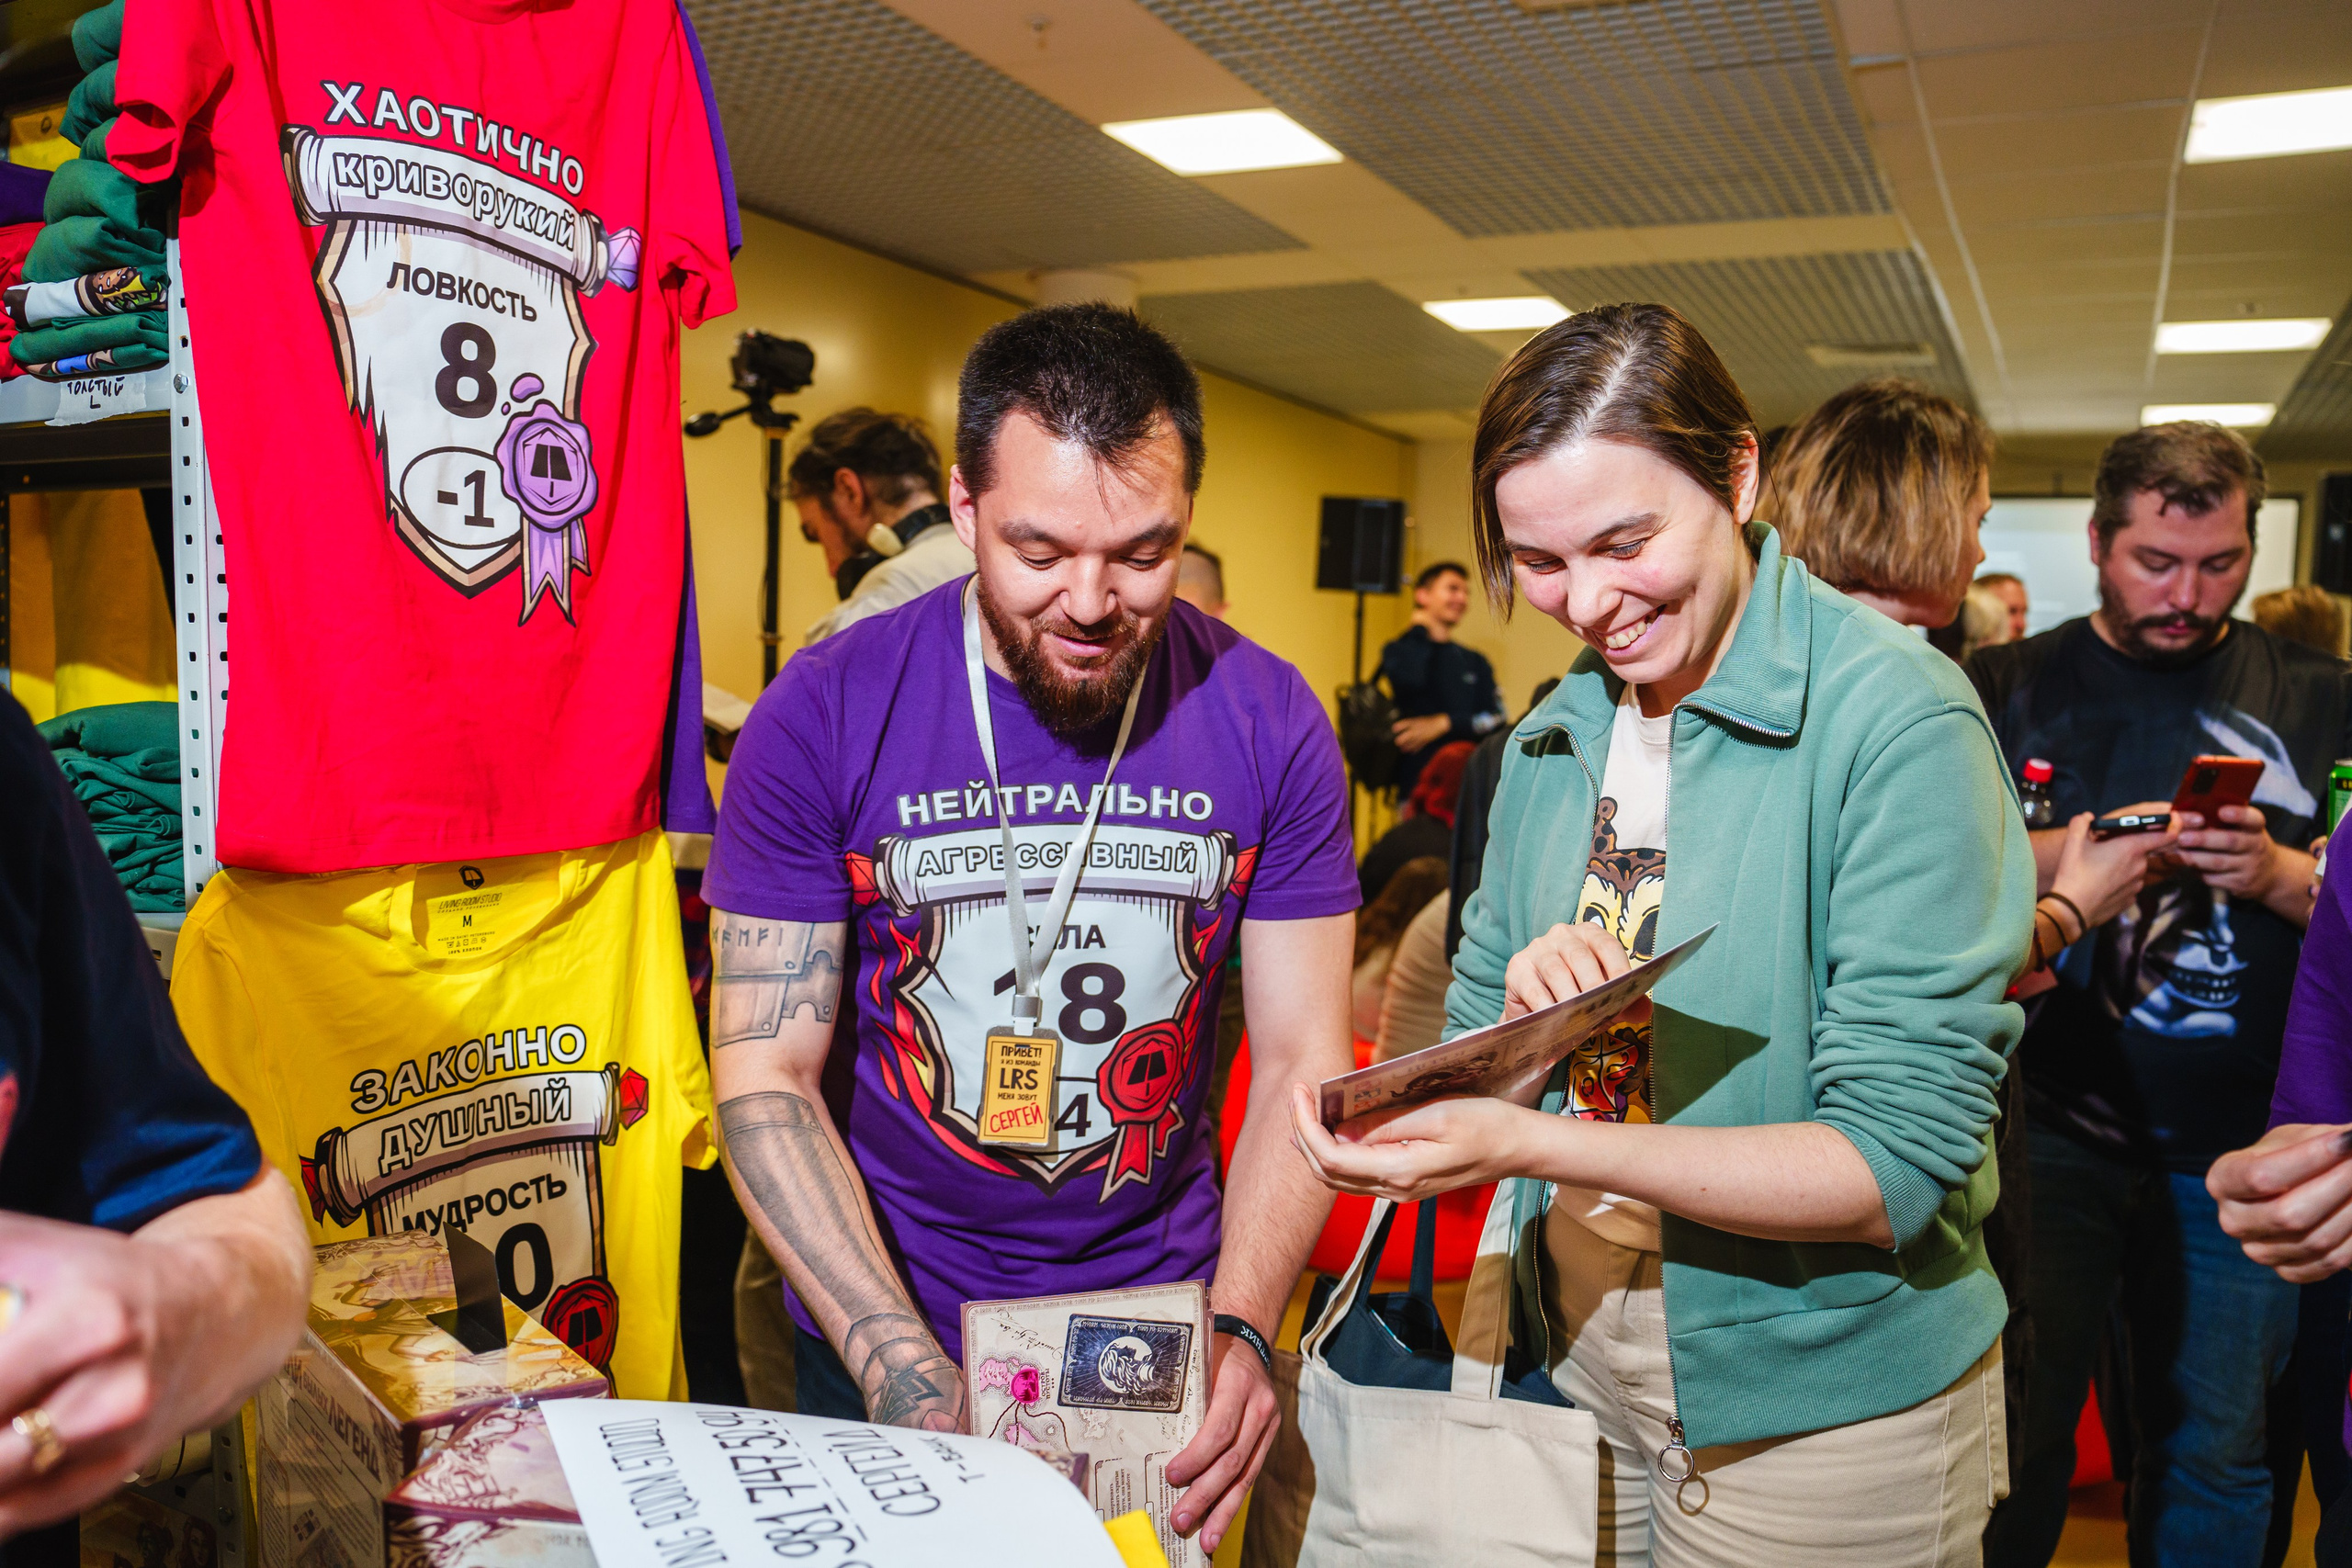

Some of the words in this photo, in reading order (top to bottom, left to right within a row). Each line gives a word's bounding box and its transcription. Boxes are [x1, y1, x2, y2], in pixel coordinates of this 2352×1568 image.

[321, 80, 584, 196] ХАОТИЧНО
[334, 152, 577, 252] криворукий
[387, 262, 537, 322] ЛОВКОСТЬ
[435, 321, 497, 419] 8
[90, 395, 101, 409] L
[437, 469, 495, 528] -1
[898, 780, 1216, 828] НЕЙТРАЛЬНО
[917, 841, 1198, 876] АГРЕССВНЫЙ
[462, 915, 472, 928] M
[351, 1024, 586, 1114] ЗАКОННО
[999, 1067, 1038, 1090] LRS
[1001, 1045, 1043, 1058] ПРИВЕТ!
[379, 1077, 571, 1178] ДУШНЫЙ
[989, 1102, 1044, 1133] СЕРГЕЙ
[402, 1173, 568, 1236] МУДРОСТЬ
